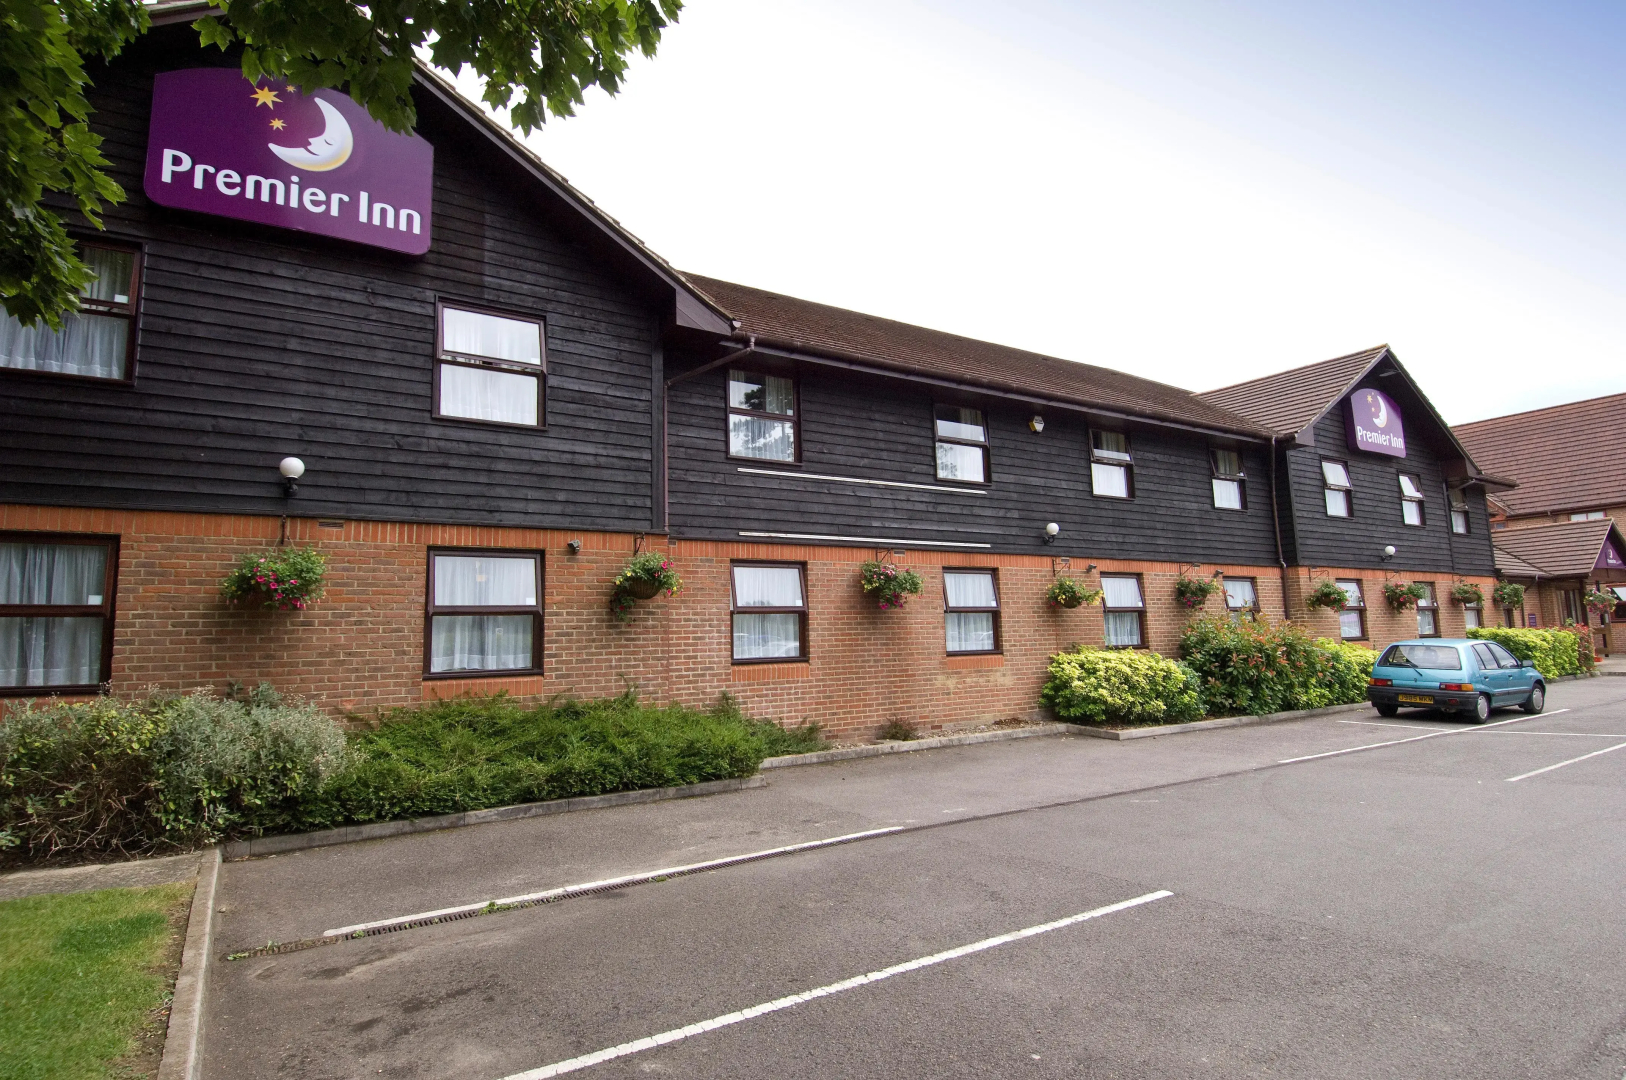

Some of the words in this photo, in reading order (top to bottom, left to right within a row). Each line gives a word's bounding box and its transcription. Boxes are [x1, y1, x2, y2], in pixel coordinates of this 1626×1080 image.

[161, 148, 349, 217] Premier
[359, 191, 421, 235] Inn
[1357, 426, 1390, 445] Premier
[1391, 433, 1403, 448] Inn
